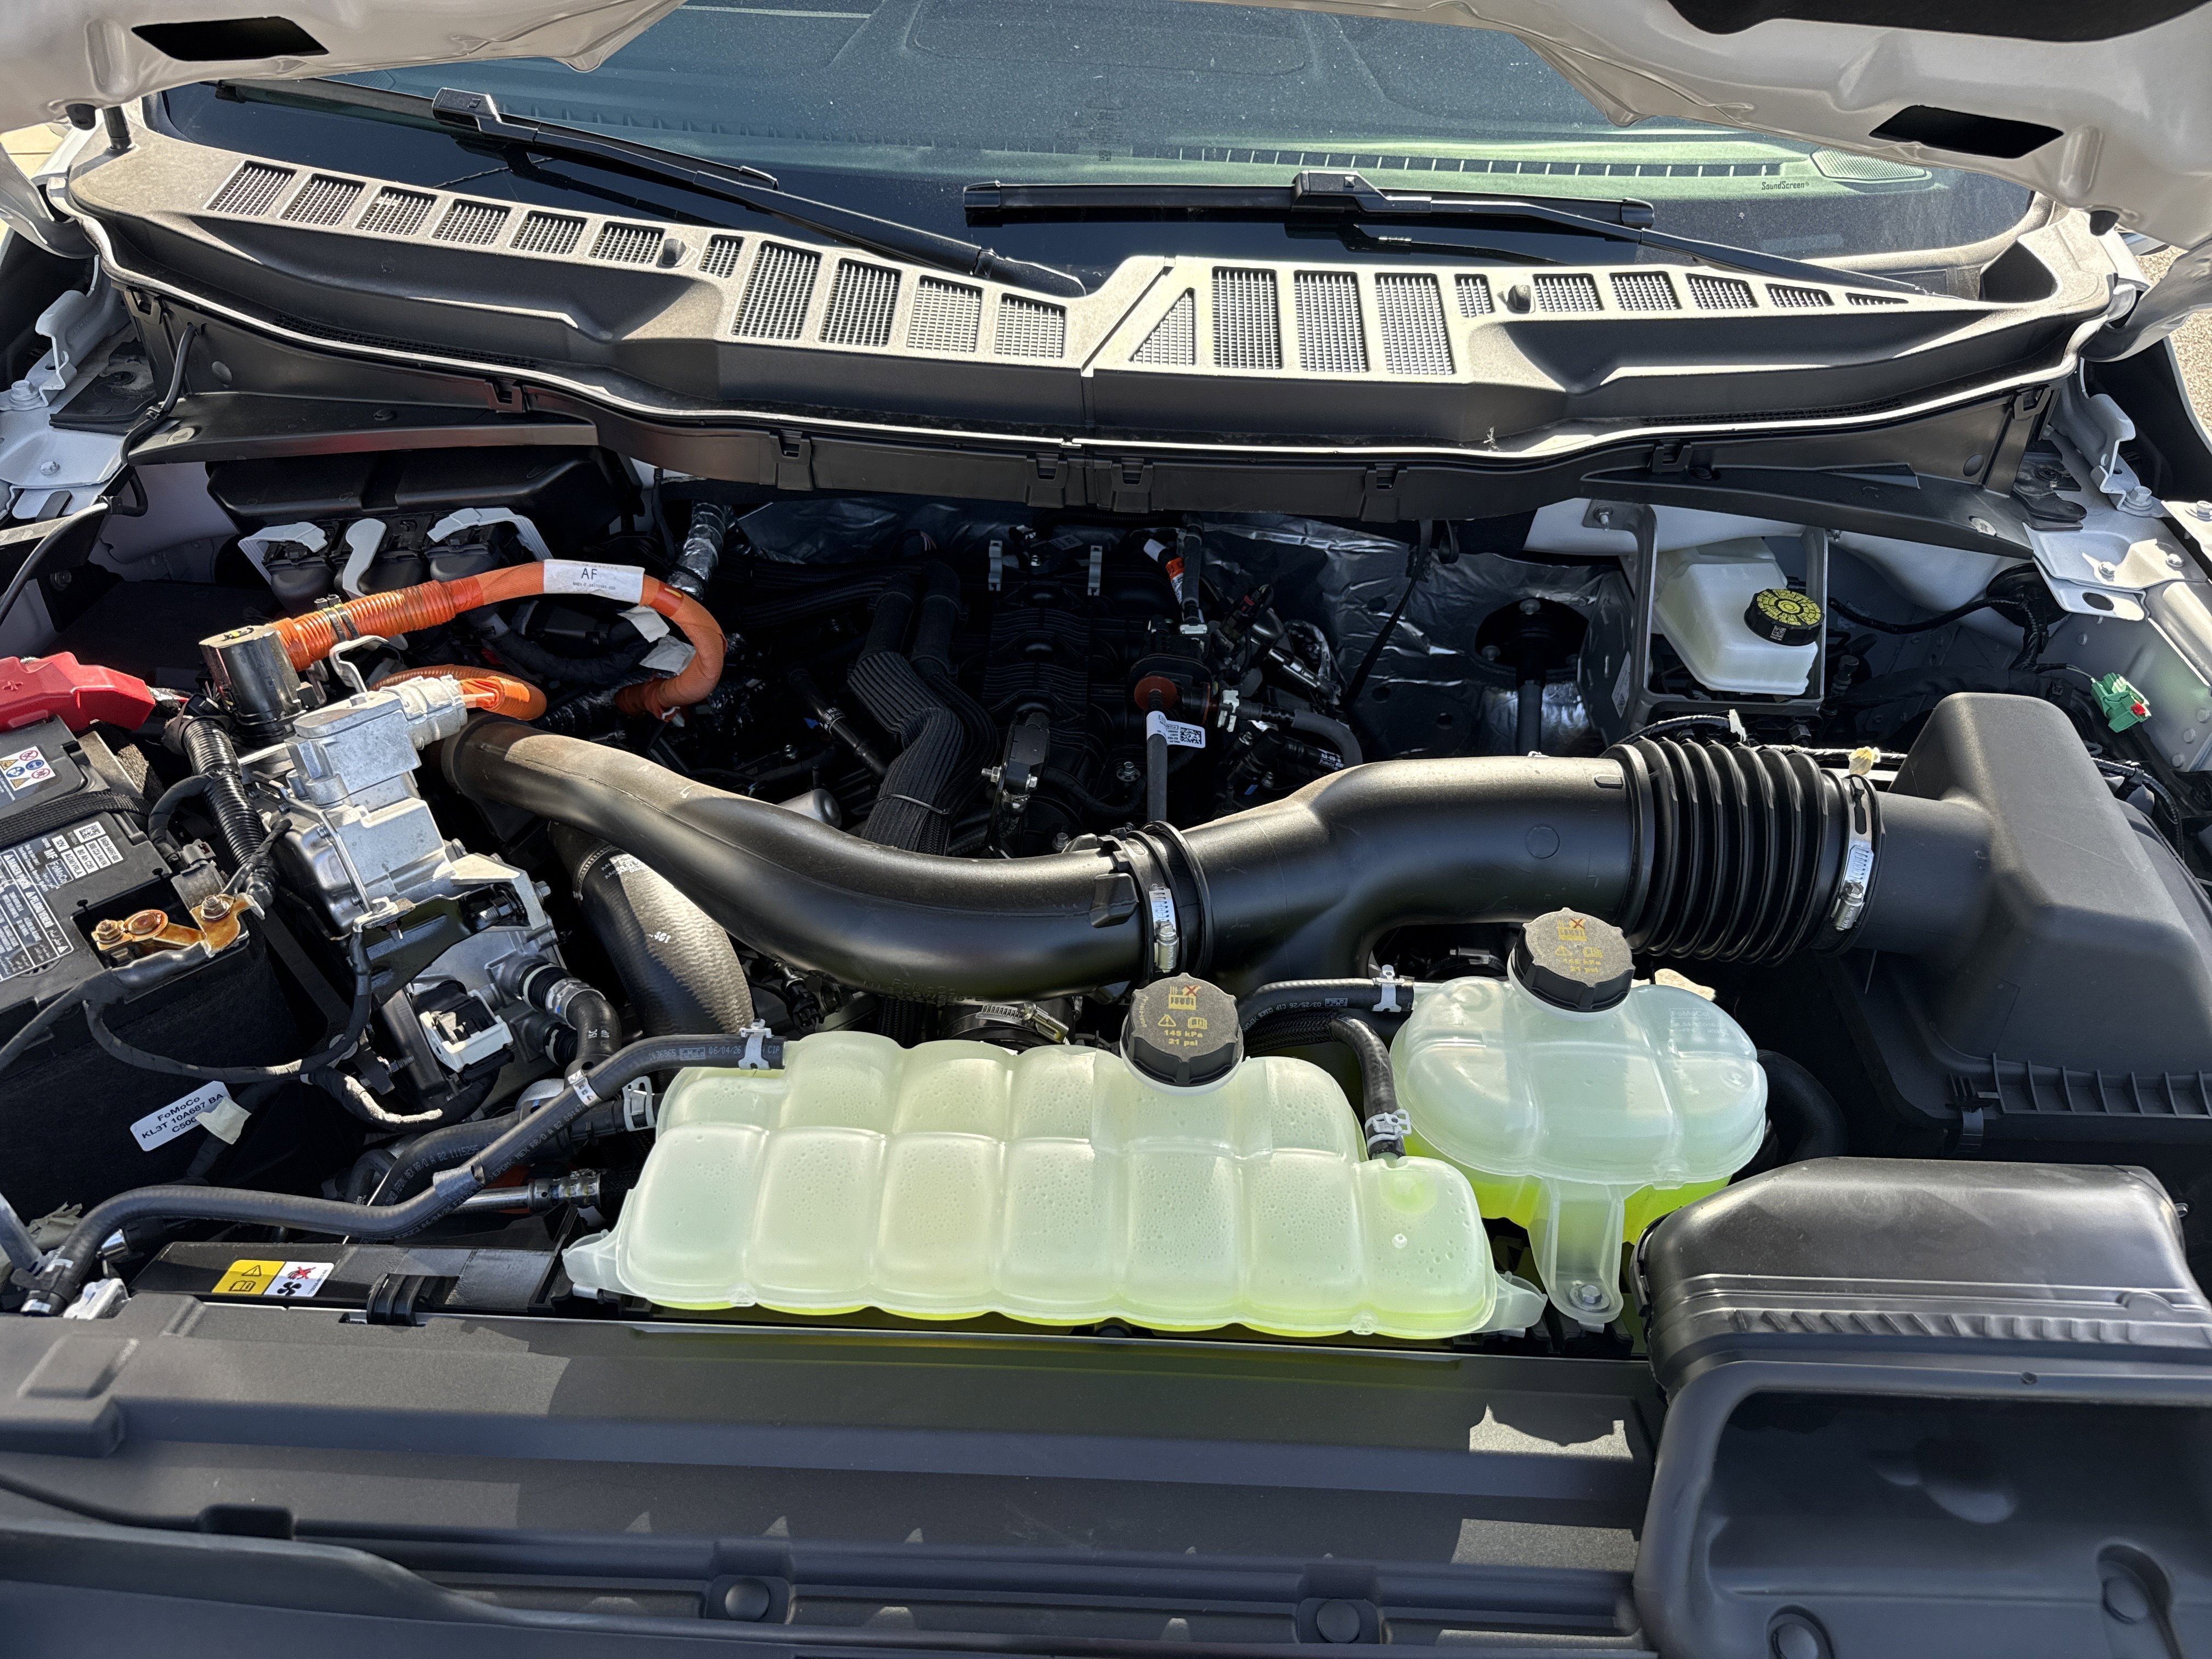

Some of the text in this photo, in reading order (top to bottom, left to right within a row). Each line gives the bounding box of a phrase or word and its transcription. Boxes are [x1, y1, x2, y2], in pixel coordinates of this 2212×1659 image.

[580, 567, 598, 580] AF
[56, 839, 66, 848] 12V
[49, 860, 67, 883] FoMoCo
[65, 854, 83, 876] AGM/VRLA
[1325, 998, 1347, 1007] FoMoCo
[1184, 1030, 1203, 1038] kPa
[680, 1047, 706, 1060] FoMoCo
[709, 1045, 742, 1055] 06/04/26
[142, 1093, 224, 1139] KL3T 10A687 BA
[157, 1097, 201, 1121] FoMoCo
[515, 1146, 532, 1160] HEX
